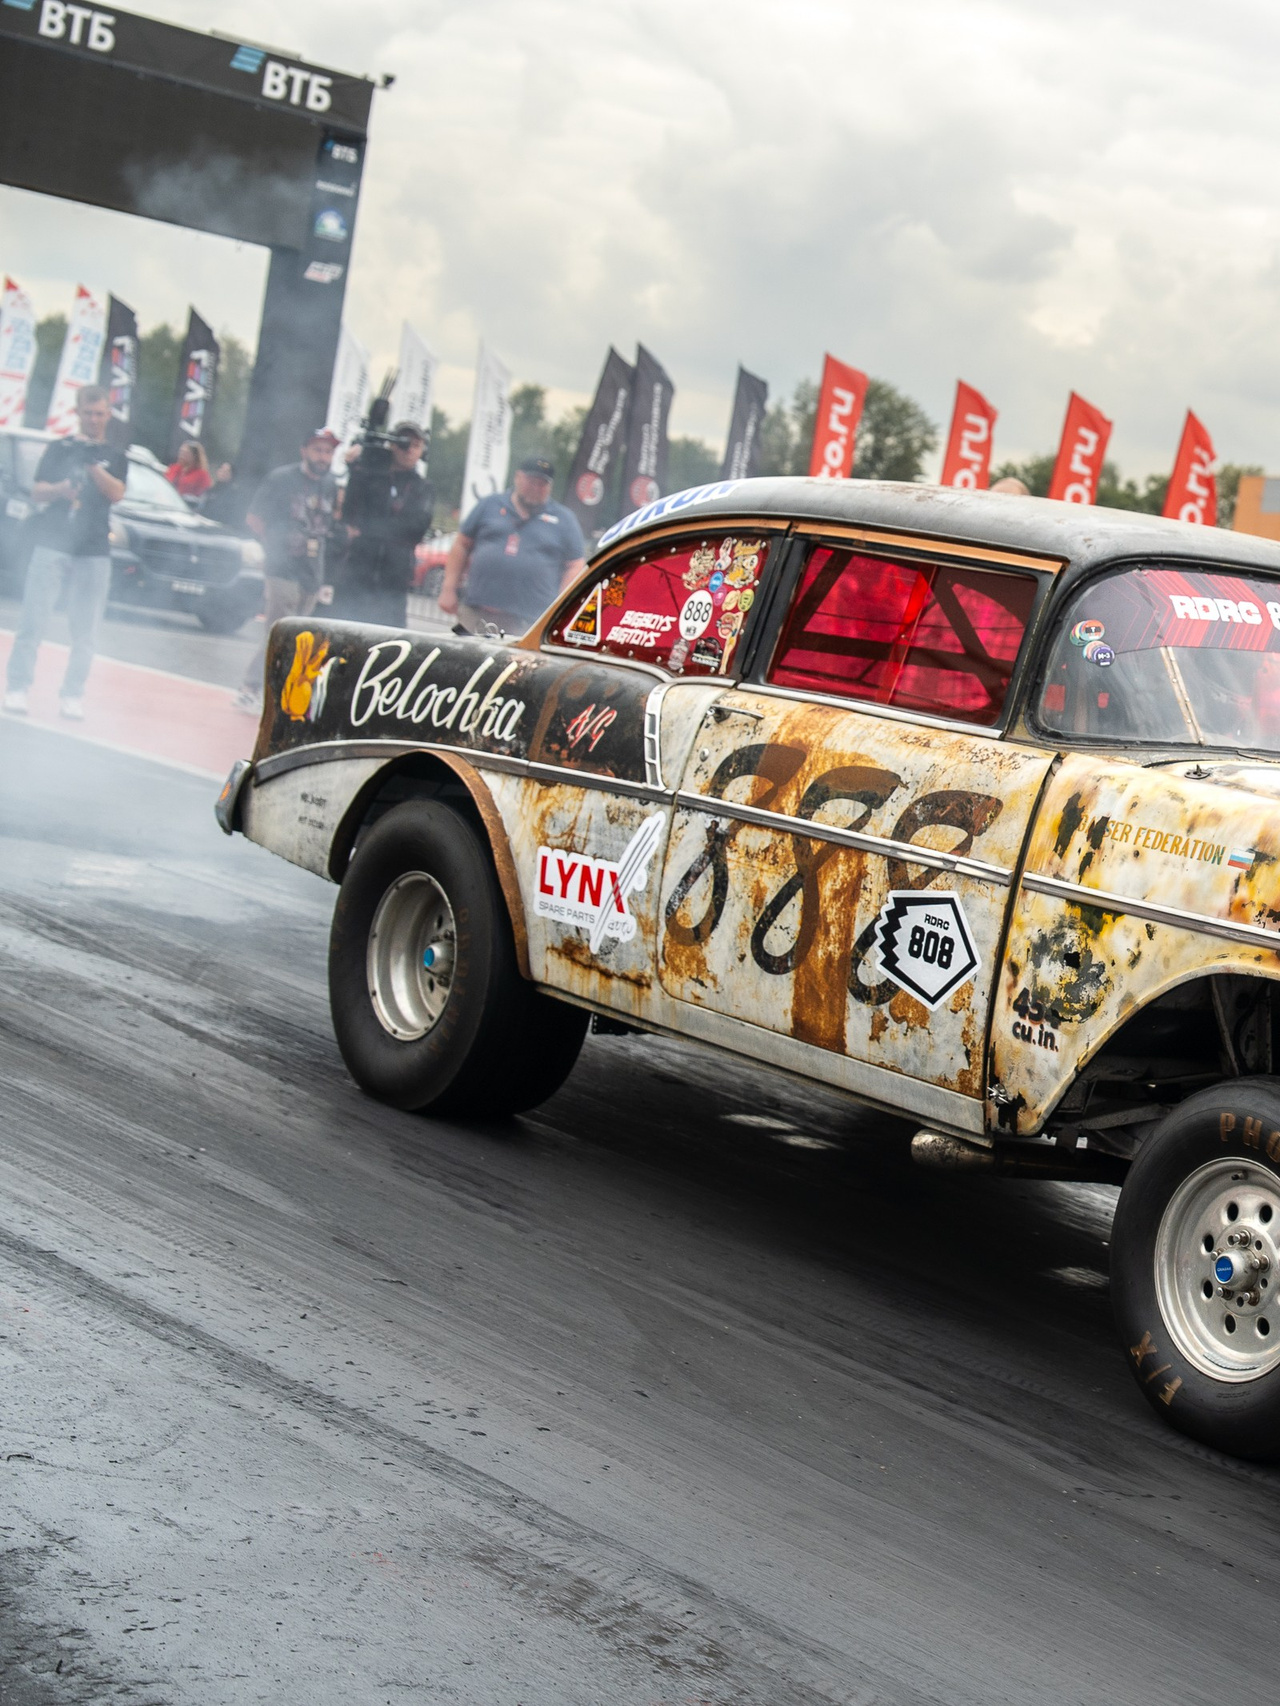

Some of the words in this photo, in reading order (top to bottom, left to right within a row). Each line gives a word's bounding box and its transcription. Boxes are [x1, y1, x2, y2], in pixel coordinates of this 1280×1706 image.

[38, 0, 116, 53] ВТБ
[262, 61, 332, 112] ВТБ
[619, 609, 677, 632] BIGBOYS
[684, 600, 712, 623] 888
[1169, 594, 1263, 625] RDRC
[606, 625, 661, 648] BIGTOYS
[351, 639, 526, 742] Belochka
[1133, 827, 1226, 866] FEDERATION
[540, 855, 625, 914] LYNX
[539, 900, 566, 917] SPARE
[566, 908, 596, 924] PARTS
[924, 913, 950, 931] RDRC
[908, 926, 955, 970] 808
